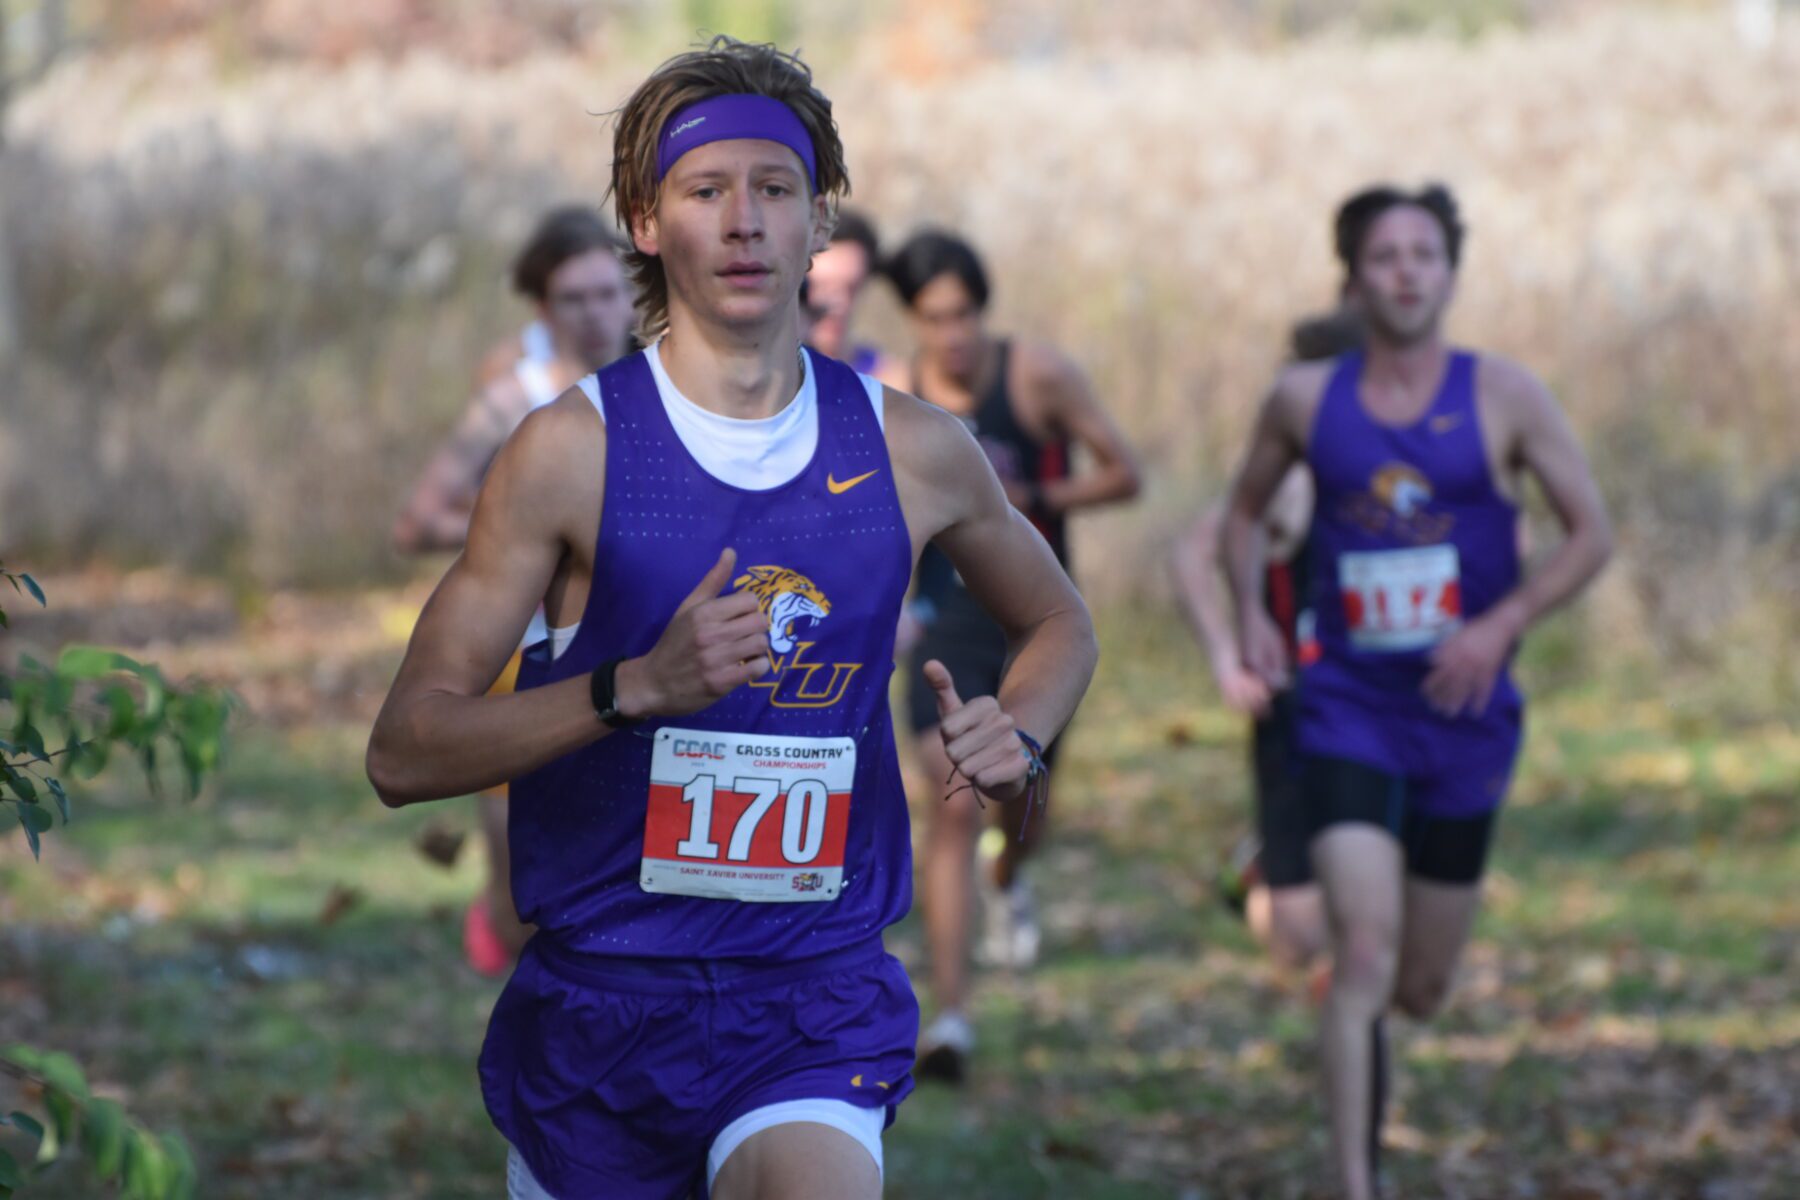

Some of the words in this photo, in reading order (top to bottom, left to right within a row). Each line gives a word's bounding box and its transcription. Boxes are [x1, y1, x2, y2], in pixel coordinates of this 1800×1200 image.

[674, 739, 726, 759] CCAC
[736, 744, 781, 757] CROSS
[784, 747, 843, 759] COUNTRY
[752, 760, 827, 769] CHAMPIONSHIPS
[676, 773, 829, 864] 170
[680, 867, 705, 876] SAINT
[707, 869, 737, 879] XAVIER
[739, 872, 785, 881] UNIVERSITY
